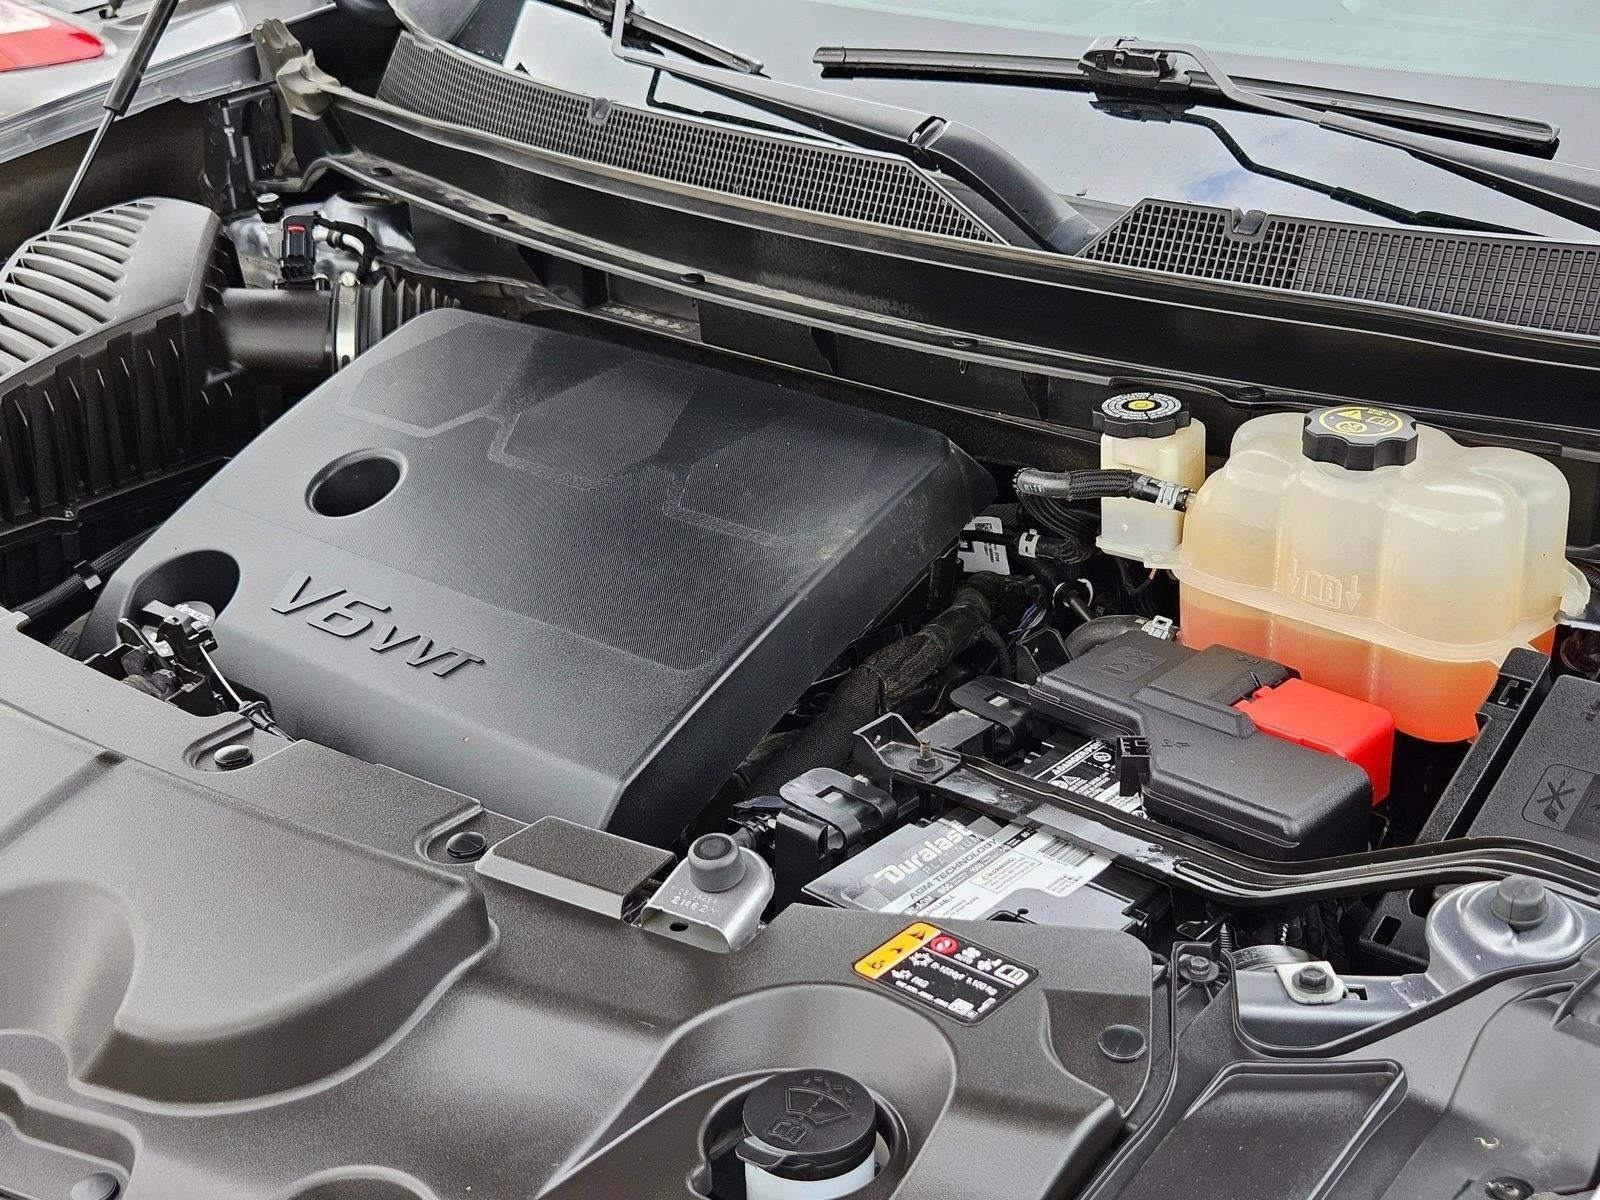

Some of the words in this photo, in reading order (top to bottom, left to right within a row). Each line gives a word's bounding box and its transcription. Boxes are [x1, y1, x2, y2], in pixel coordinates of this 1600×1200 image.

[271, 571, 392, 638] V6
[369, 623, 485, 678] VVT
[873, 820, 974, 885] Duralast
[909, 882, 934, 900] AGM
[933, 838, 997, 884] TECHNOLOGY
